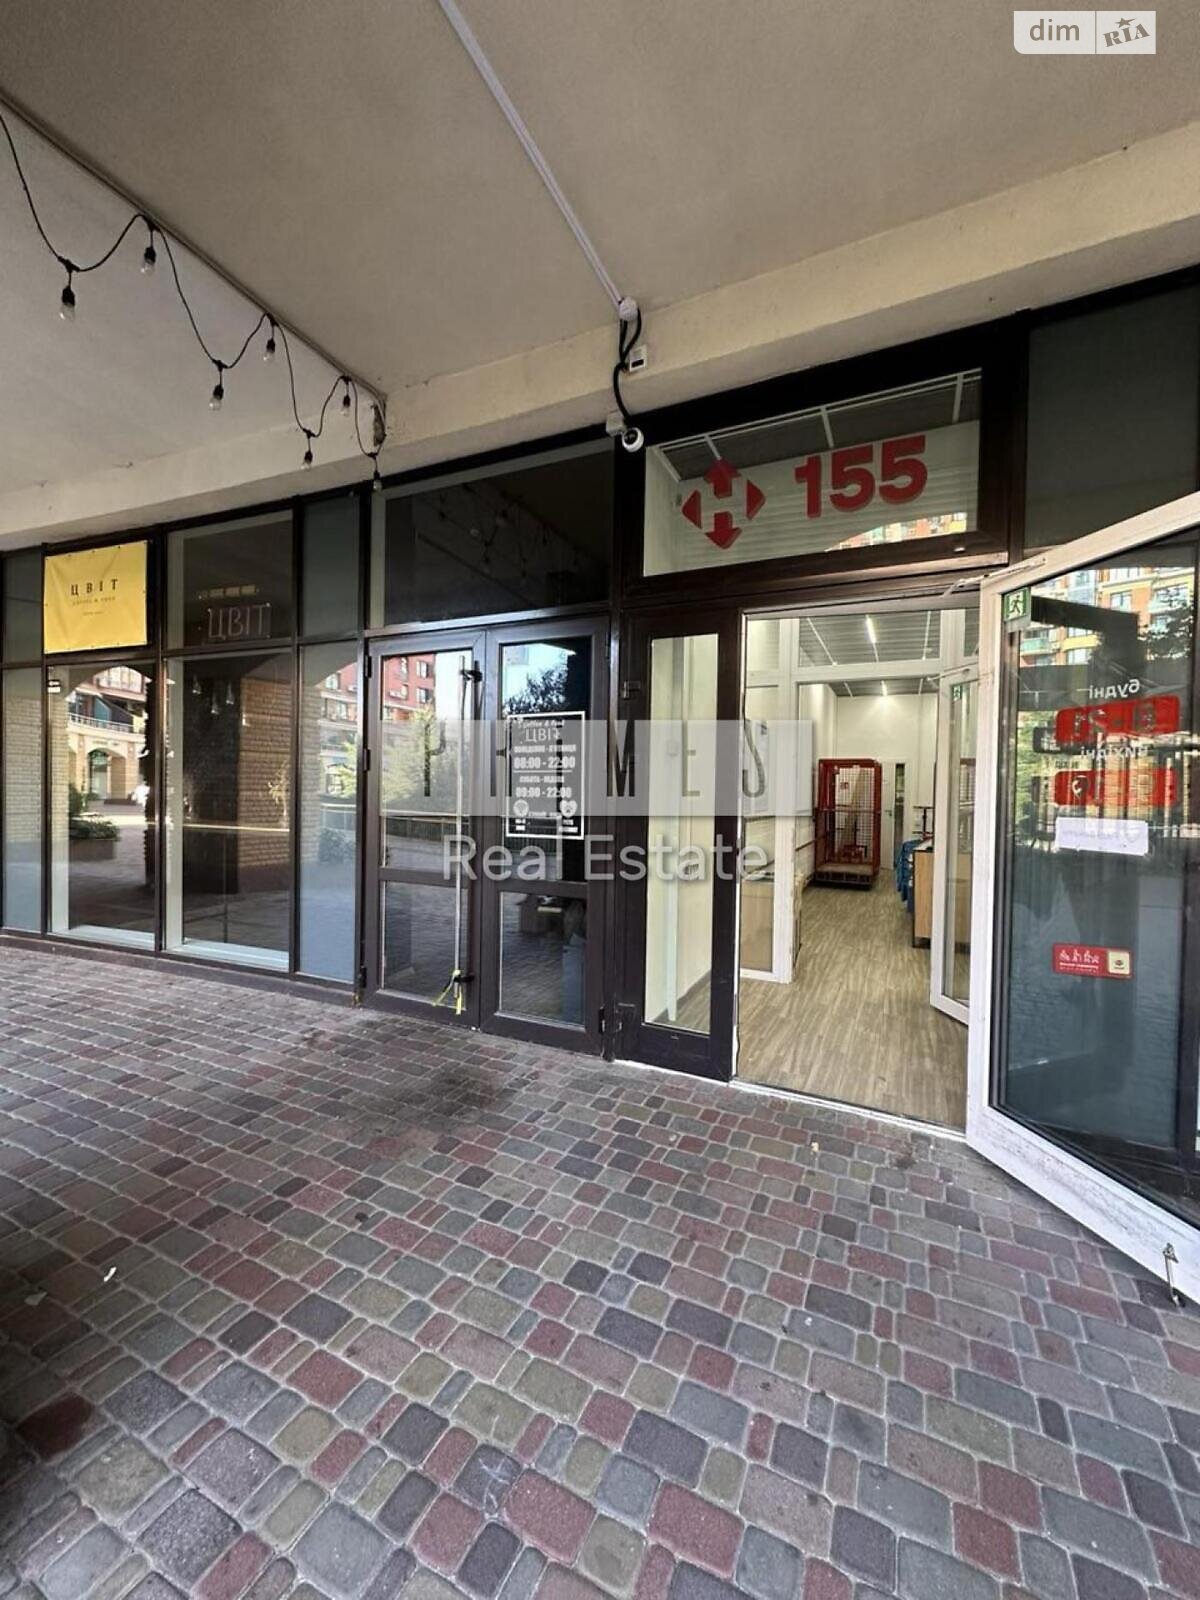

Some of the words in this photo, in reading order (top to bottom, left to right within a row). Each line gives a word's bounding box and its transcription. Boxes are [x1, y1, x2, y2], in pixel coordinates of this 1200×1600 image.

[795, 435, 928, 519] 155
[70, 578, 119, 597] ЦВІТ
[207, 603, 271, 641] ЦВІТ
